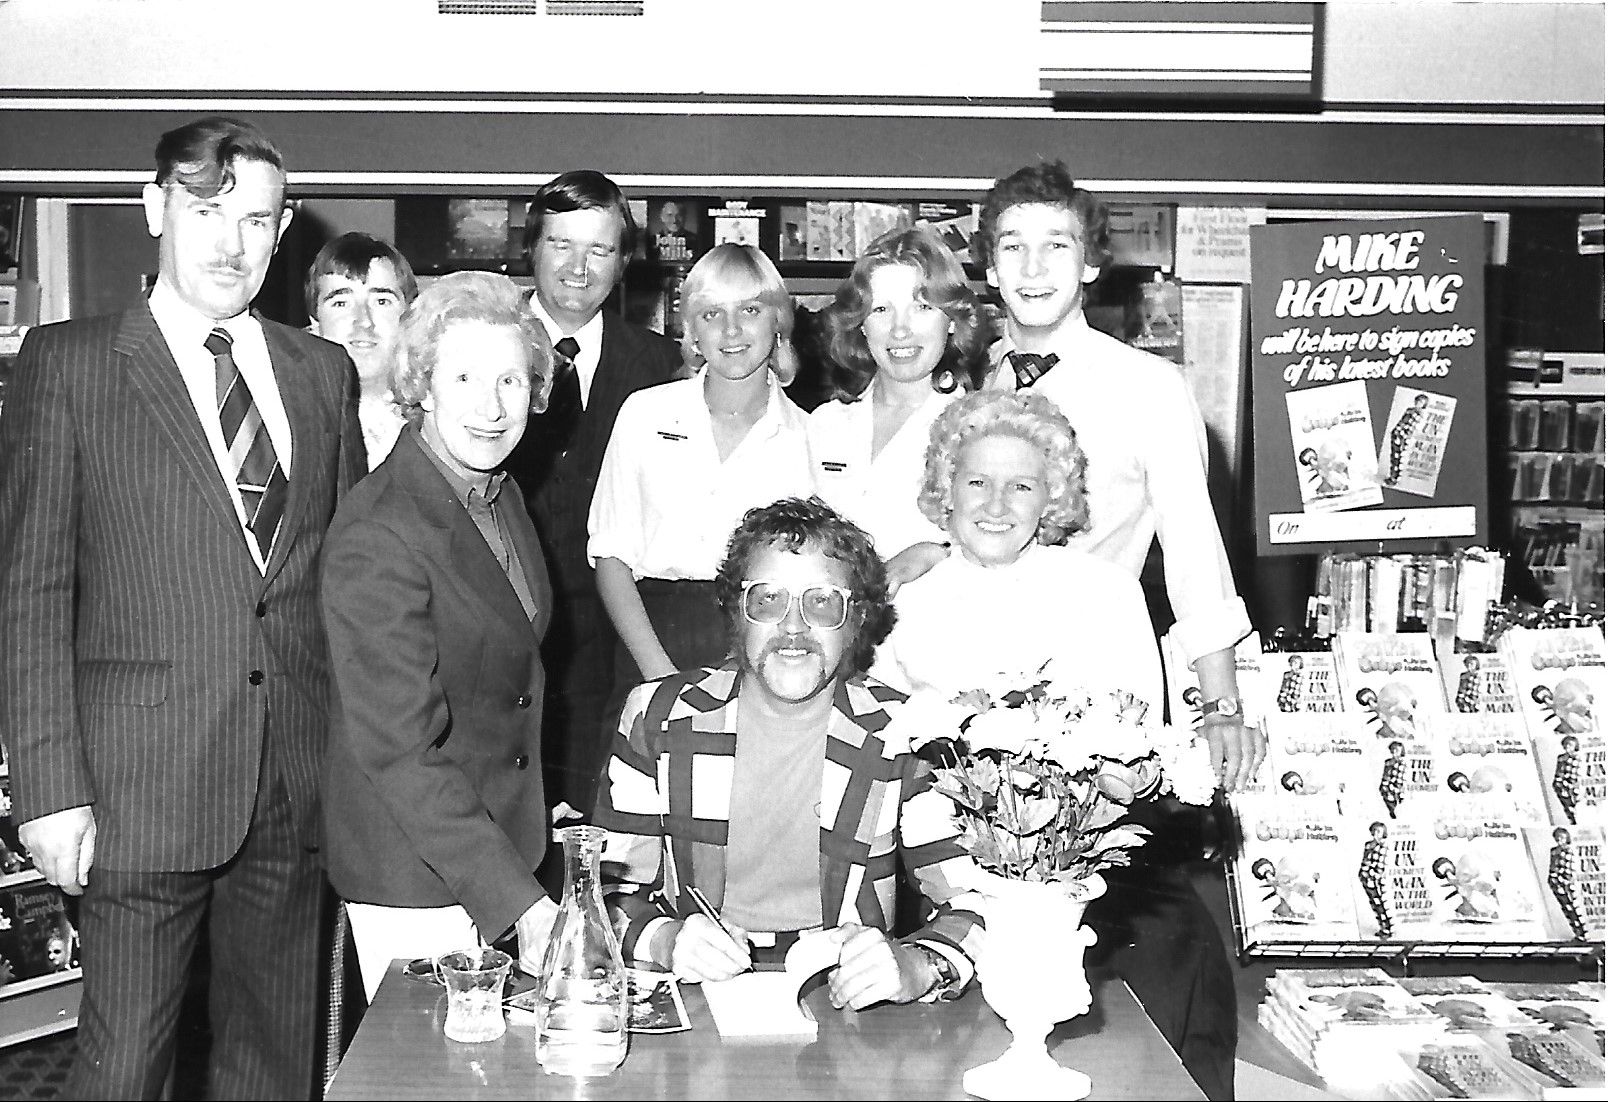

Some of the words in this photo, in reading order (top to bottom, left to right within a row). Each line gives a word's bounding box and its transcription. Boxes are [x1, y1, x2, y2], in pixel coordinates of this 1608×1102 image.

[1315, 230, 1425, 274] MIKE
[1275, 274, 1464, 319] HARDING
[1261, 327, 1302, 355] will
[1296, 327, 1320, 354] be
[1318, 327, 1359, 352] here
[1359, 329, 1379, 351] to
[1378, 325, 1420, 356] sign
[1418, 324, 1476, 353] copies
[1283, 354, 1312, 387] of
[1307, 355, 1338, 382] his
[1338, 355, 1394, 380] latest
[1391, 353, 1452, 378] books
[1277, 520, 1300, 536] On
[1386, 516, 1406, 531] at
[1390, 876, 1427, 890] MAN
[1395, 900, 1433, 910] WORLD
